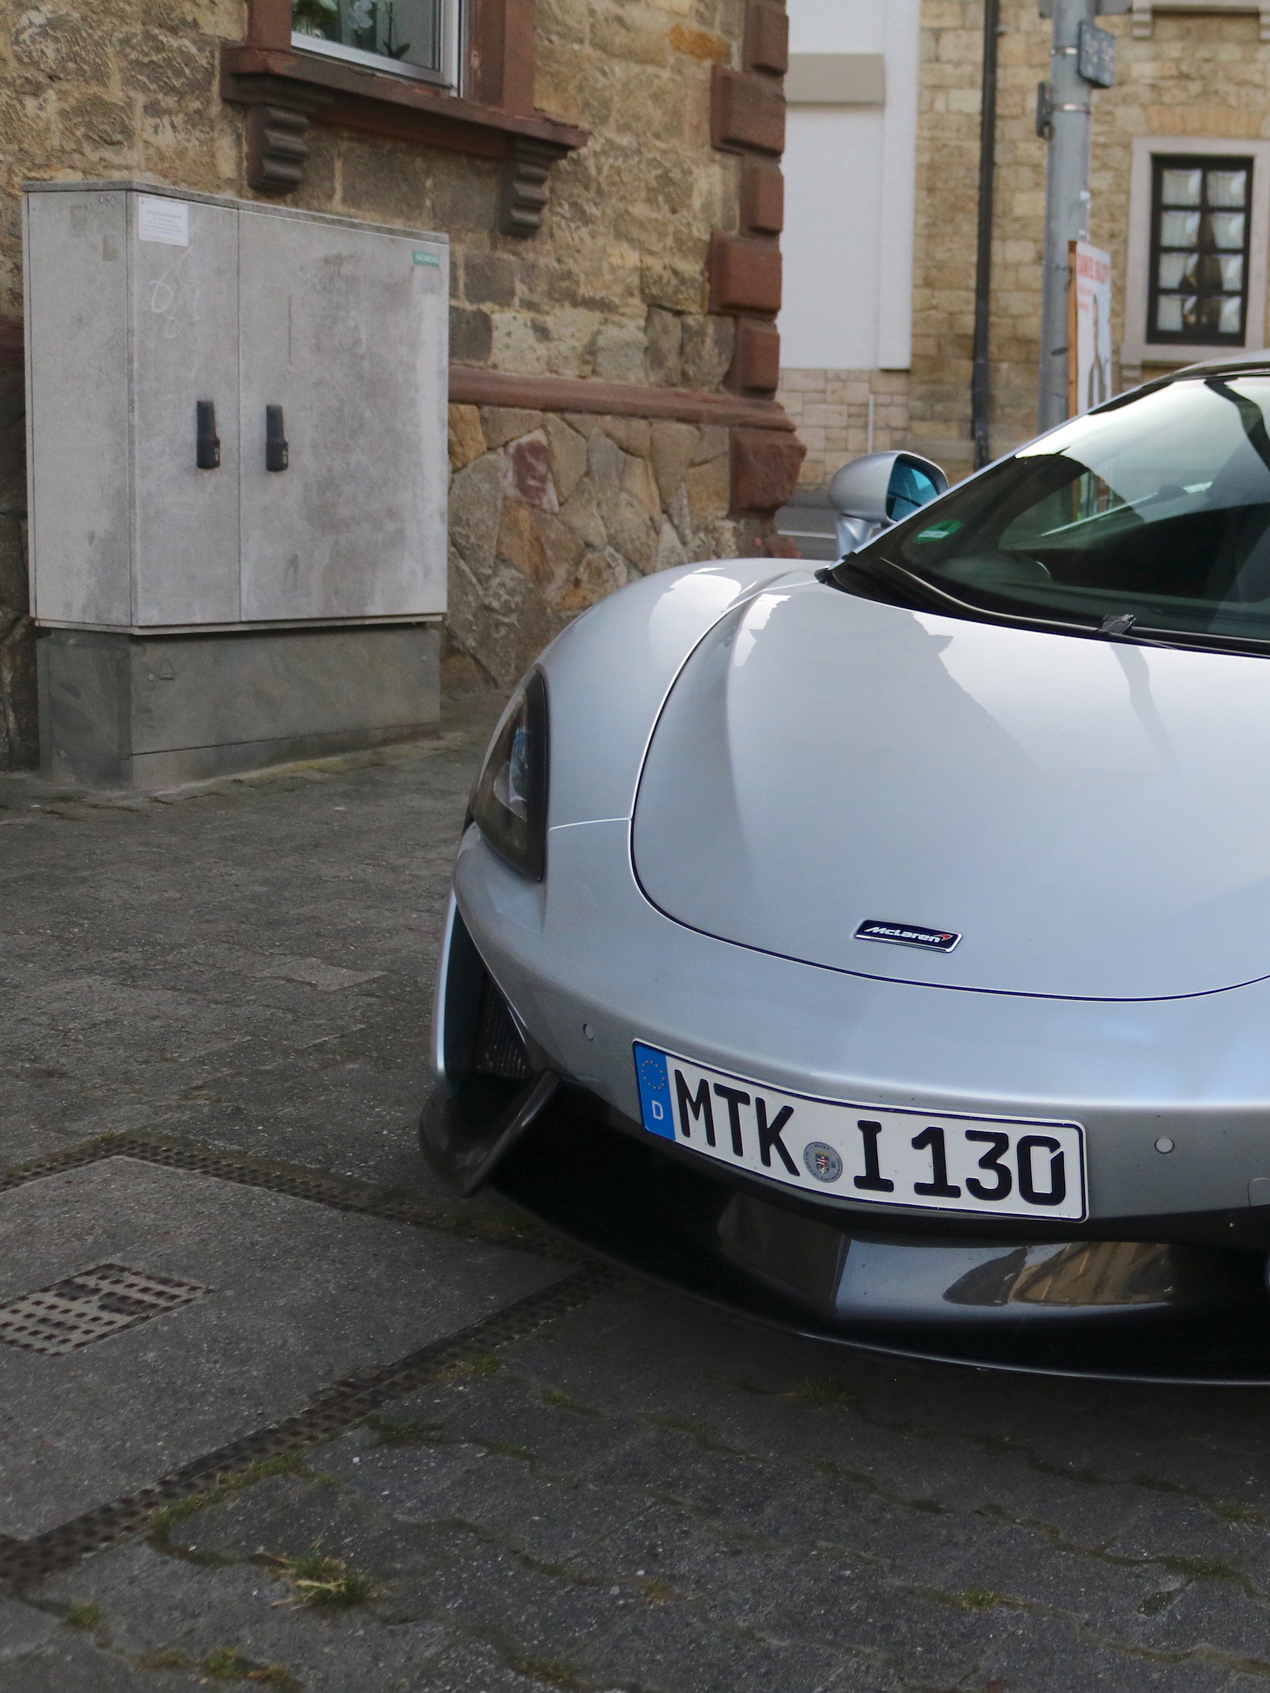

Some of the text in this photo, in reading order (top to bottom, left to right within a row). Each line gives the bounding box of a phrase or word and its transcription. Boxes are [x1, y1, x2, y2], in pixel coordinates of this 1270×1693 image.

[864, 926, 941, 943] McLaren
[651, 1100, 664, 1120] D
[674, 1069, 800, 1177] MTK
[853, 1119, 894, 1193] I
[911, 1126, 1066, 1206] 130
